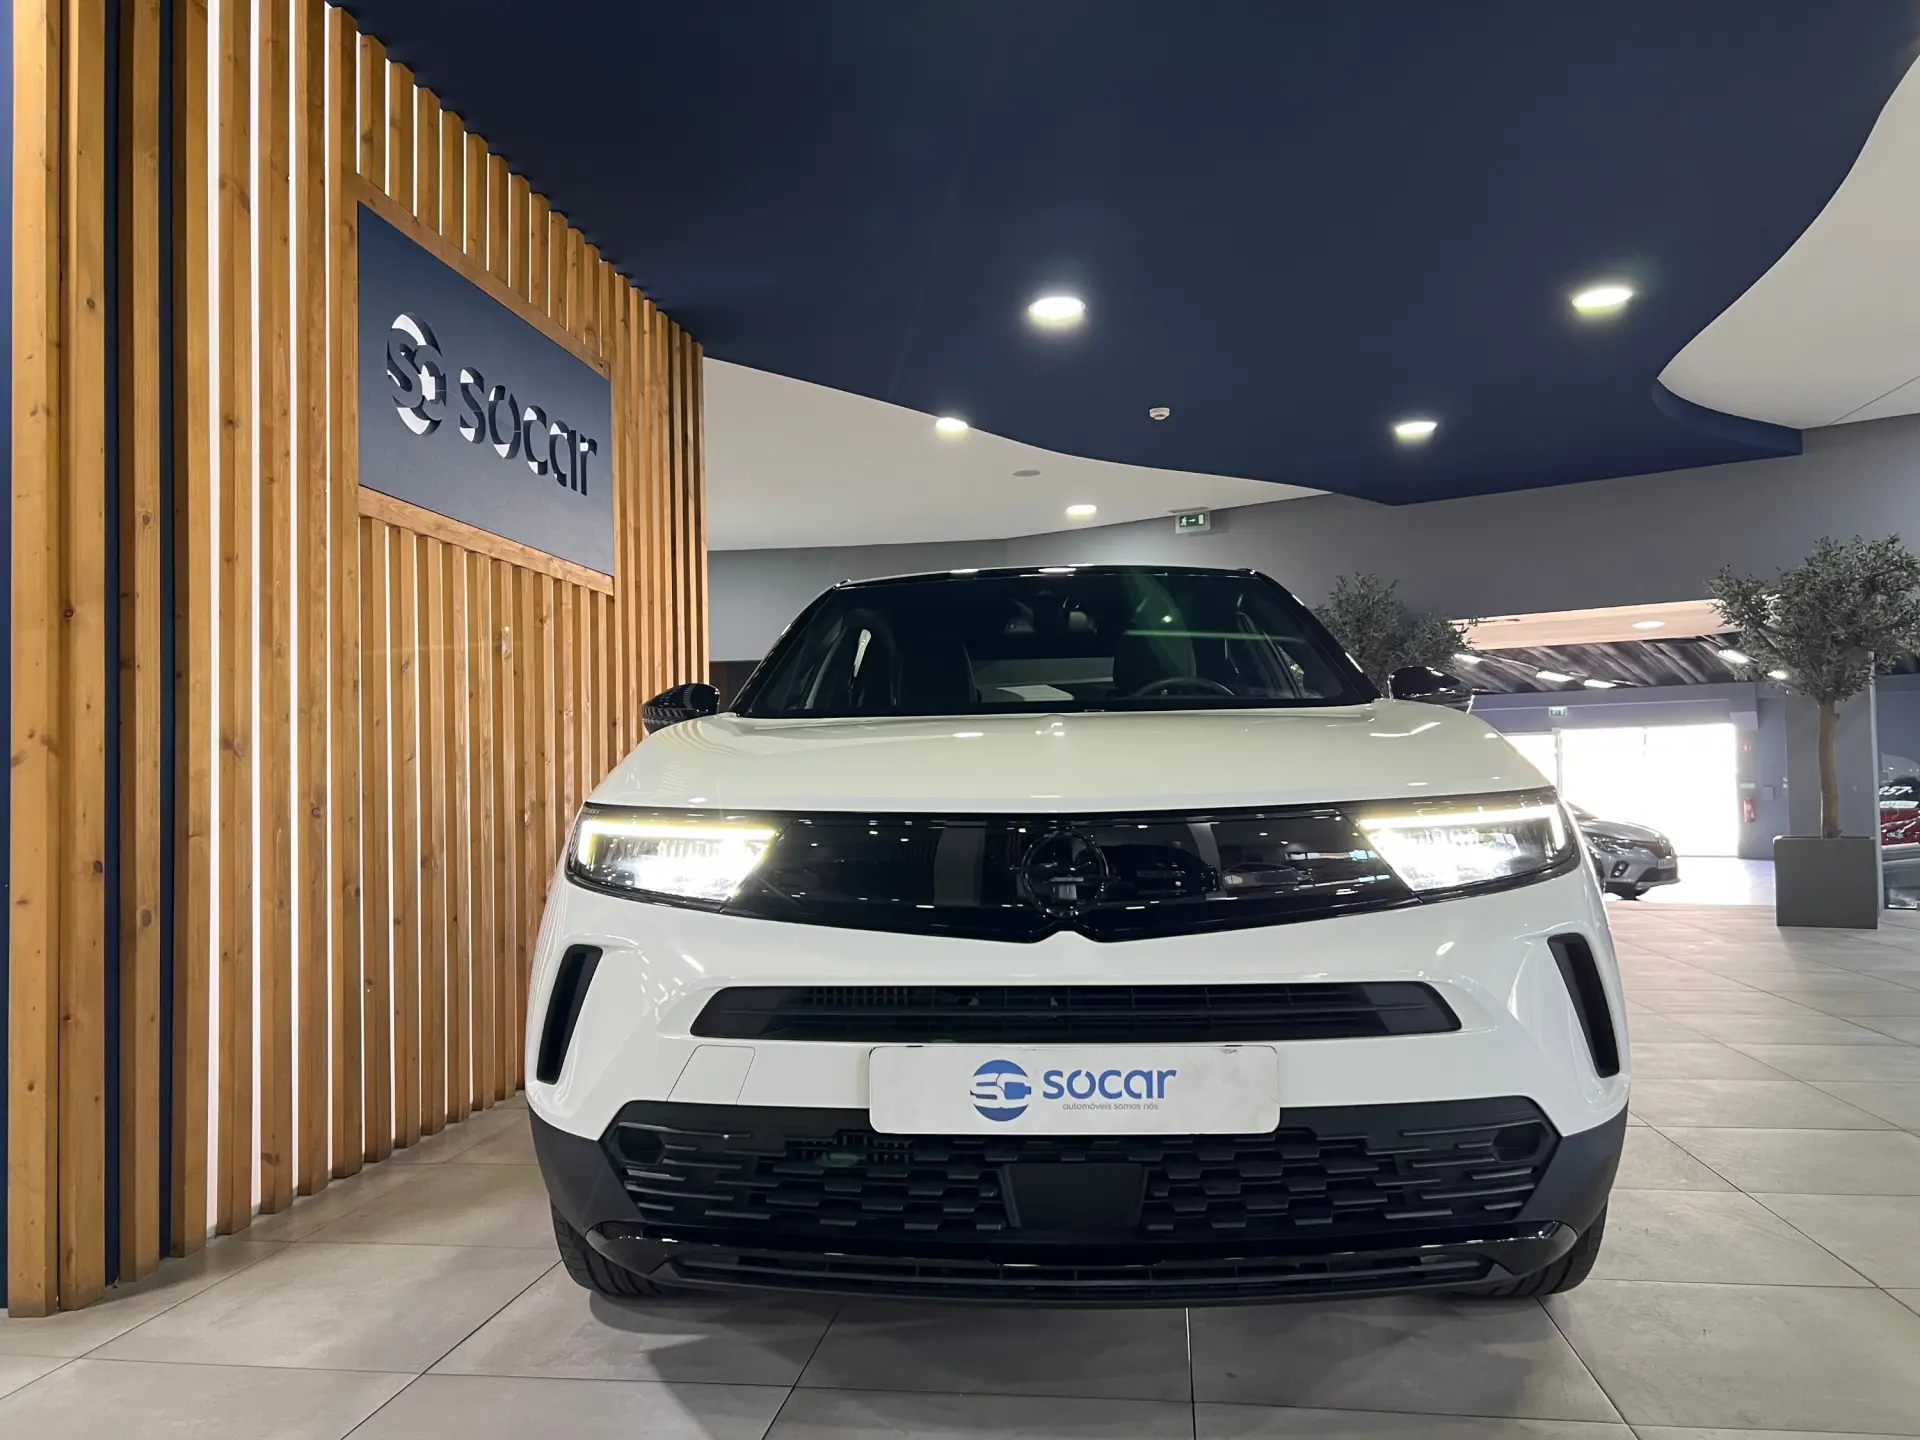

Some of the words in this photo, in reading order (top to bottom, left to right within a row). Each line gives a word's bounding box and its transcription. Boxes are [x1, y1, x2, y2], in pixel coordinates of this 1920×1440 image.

[459, 366, 598, 496] socar
[1042, 1069, 1177, 1100] socar
[1062, 1101, 1112, 1110] automóveis
[1113, 1102, 1141, 1110] somos
[1143, 1101, 1159, 1110] nós
